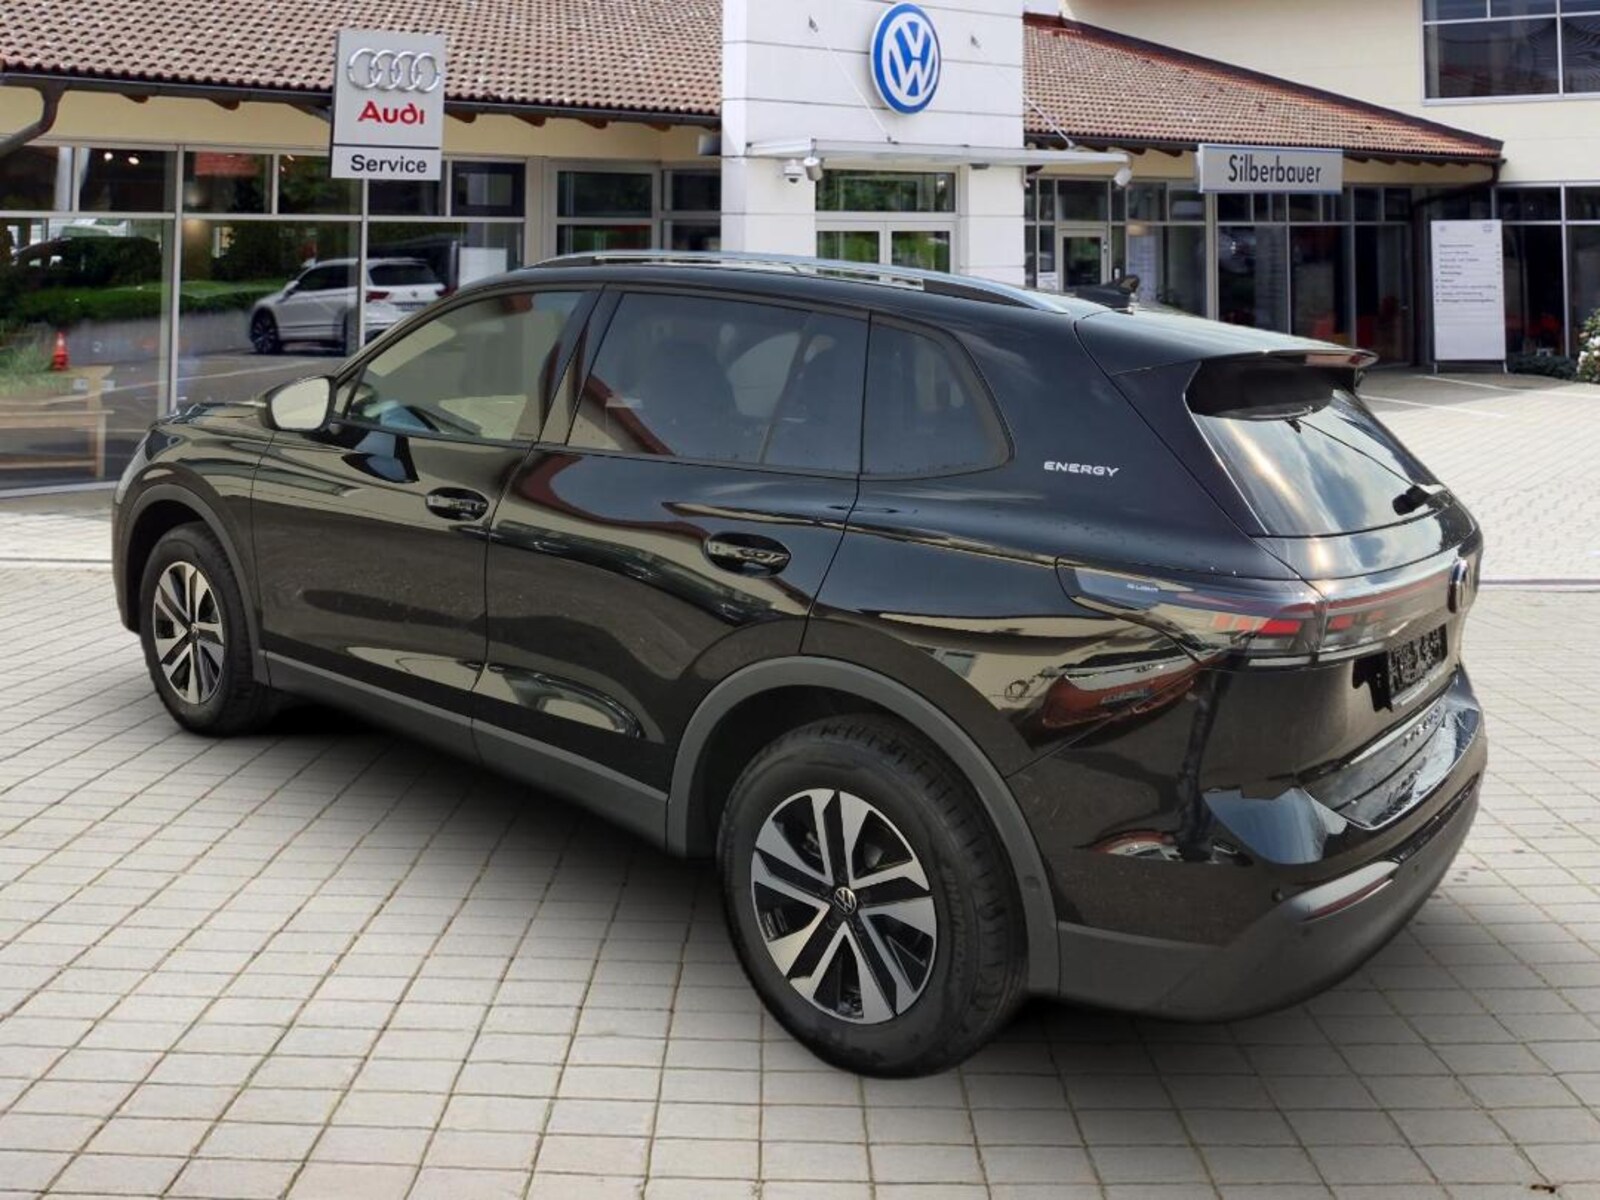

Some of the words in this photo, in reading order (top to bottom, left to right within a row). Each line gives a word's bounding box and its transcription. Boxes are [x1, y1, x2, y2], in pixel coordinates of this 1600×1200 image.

[358, 101, 425, 125] Audi
[351, 154, 427, 173] Service
[1228, 154, 1321, 183] Silberbauer
[1043, 461, 1119, 477] ENERGY
